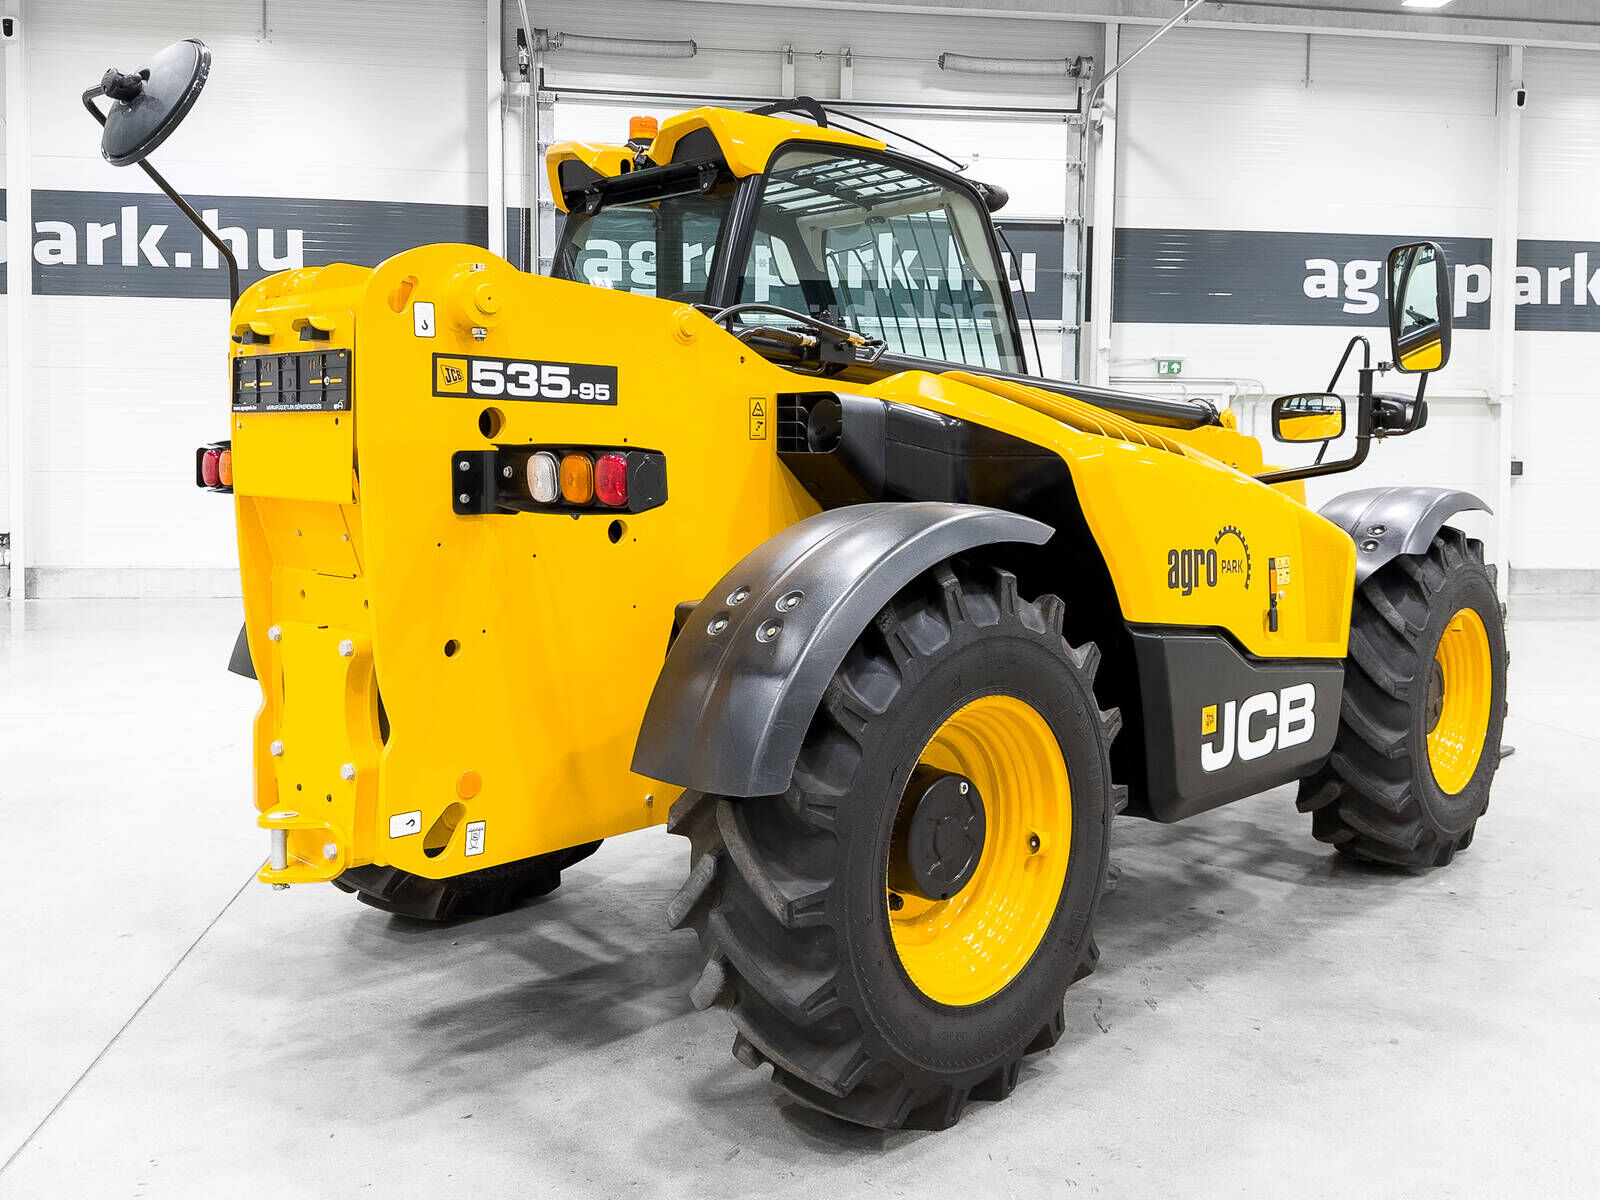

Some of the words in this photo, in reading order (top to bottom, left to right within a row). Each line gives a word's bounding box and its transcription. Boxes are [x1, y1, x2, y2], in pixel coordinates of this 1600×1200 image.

[0, 205, 304, 272] ark.hu
[1303, 251, 1600, 318] agpark
[445, 367, 463, 384] JCB
[471, 359, 611, 401] 535-95
[1167, 548, 1218, 597] agro
[1221, 559, 1244, 574] PARK
[1201, 682, 1316, 772] JCB
